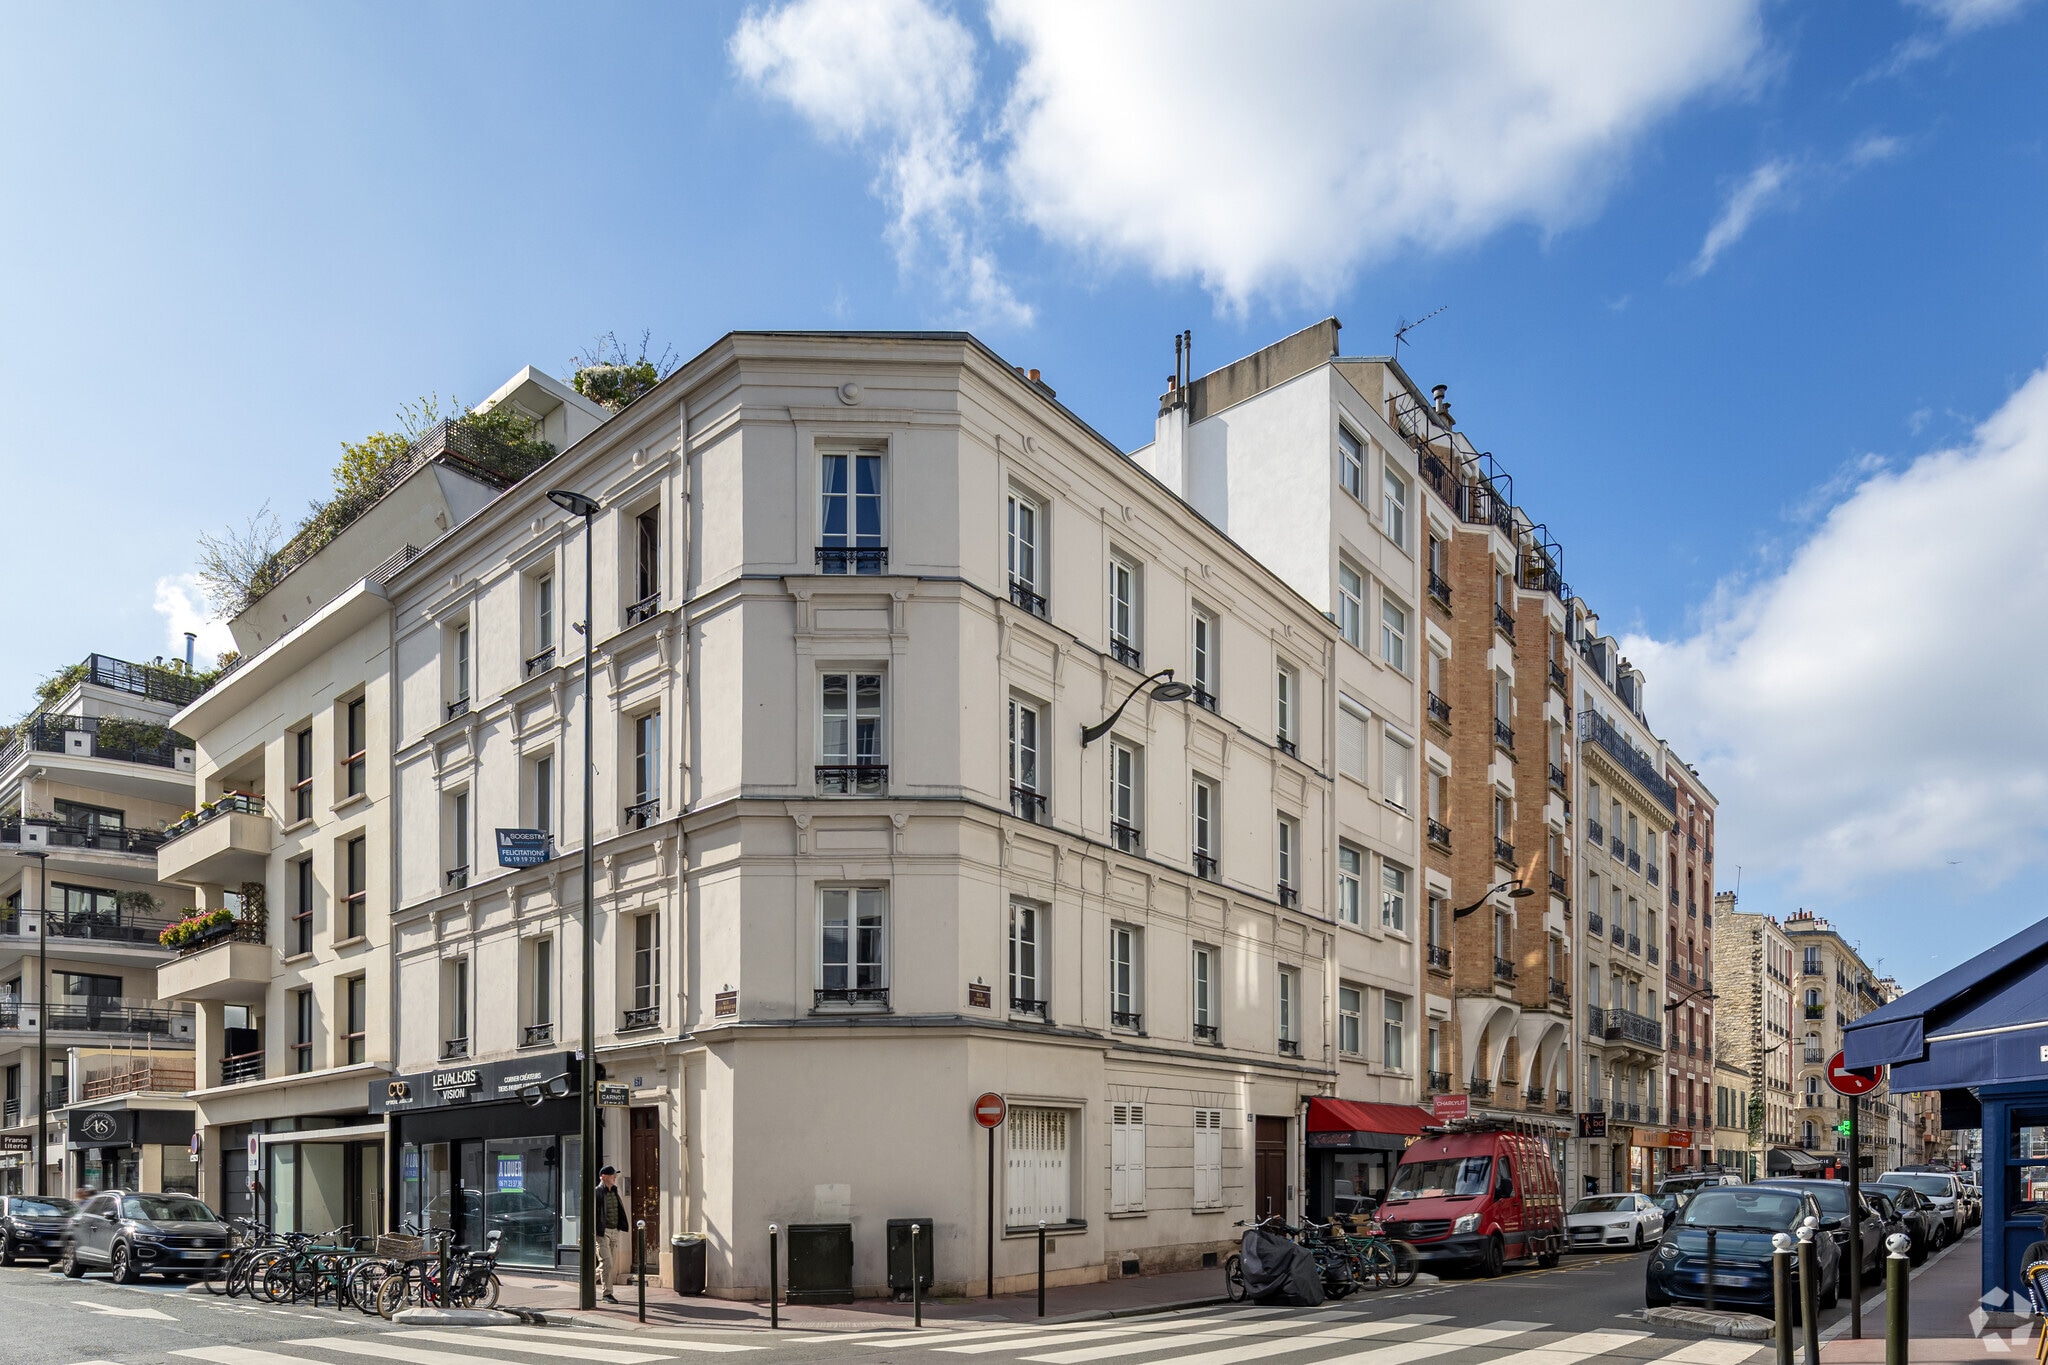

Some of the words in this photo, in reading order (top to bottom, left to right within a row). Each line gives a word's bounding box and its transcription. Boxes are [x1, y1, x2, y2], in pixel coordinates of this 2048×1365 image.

[433, 1070, 476, 1087] LEVALLOIS
[442, 1088, 464, 1100] VISION
[499, 1161, 503, 1177] A
[504, 1161, 522, 1177] LOUER
